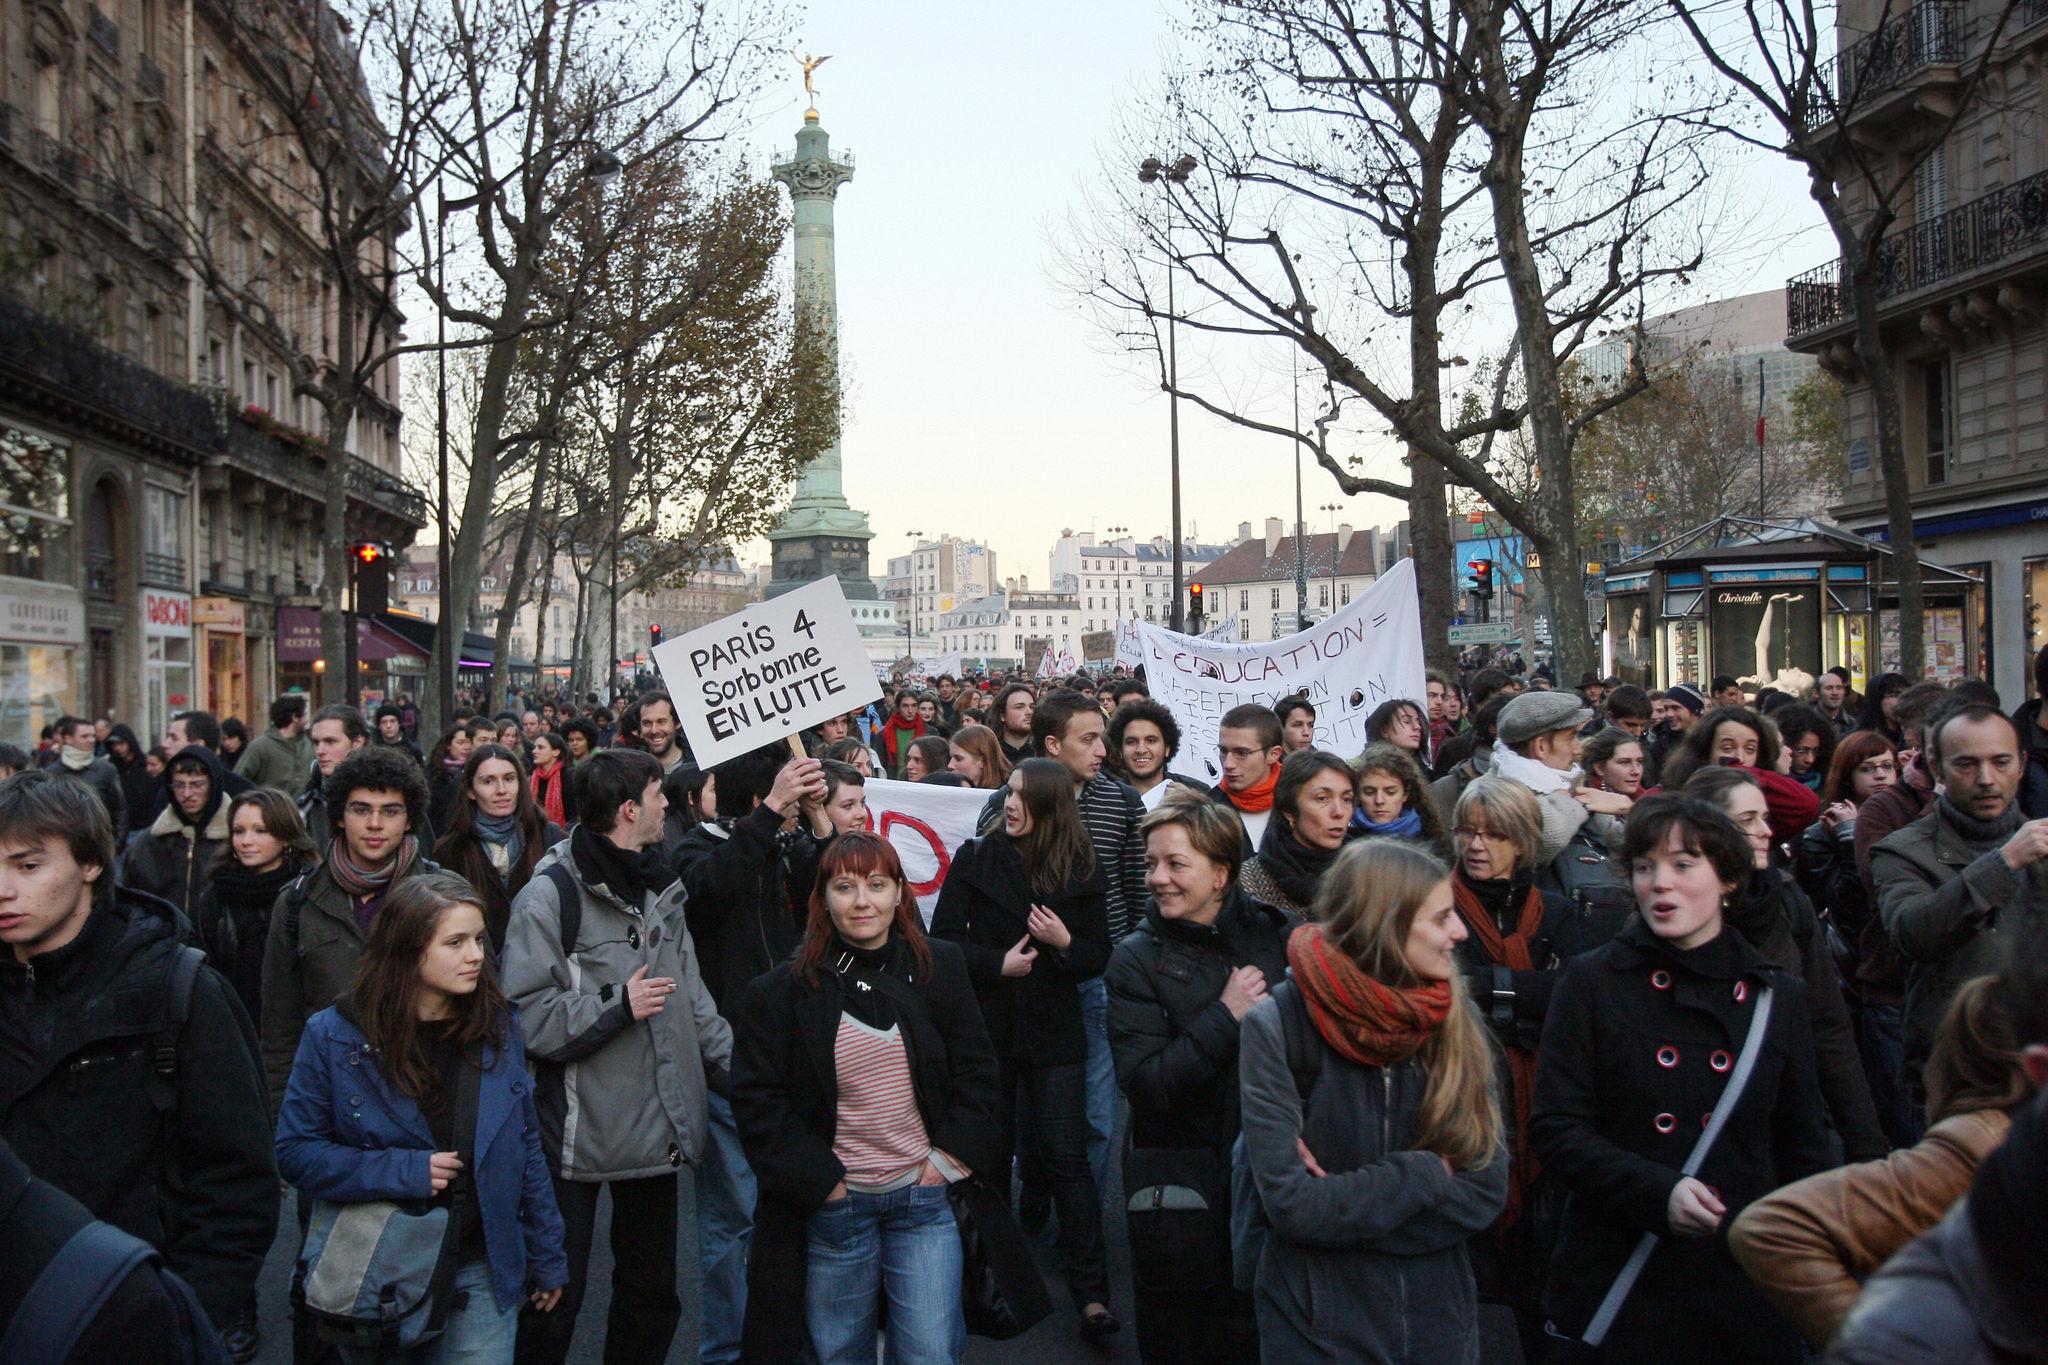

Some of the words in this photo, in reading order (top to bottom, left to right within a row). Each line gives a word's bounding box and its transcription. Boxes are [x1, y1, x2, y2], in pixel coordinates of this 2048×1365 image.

[1528, 554, 1537, 565] M
[792, 607, 817, 640] 4
[701, 646, 823, 708] Sorbonne
[705, 701, 752, 743] EN
[753, 665, 847, 723] LUTTE
